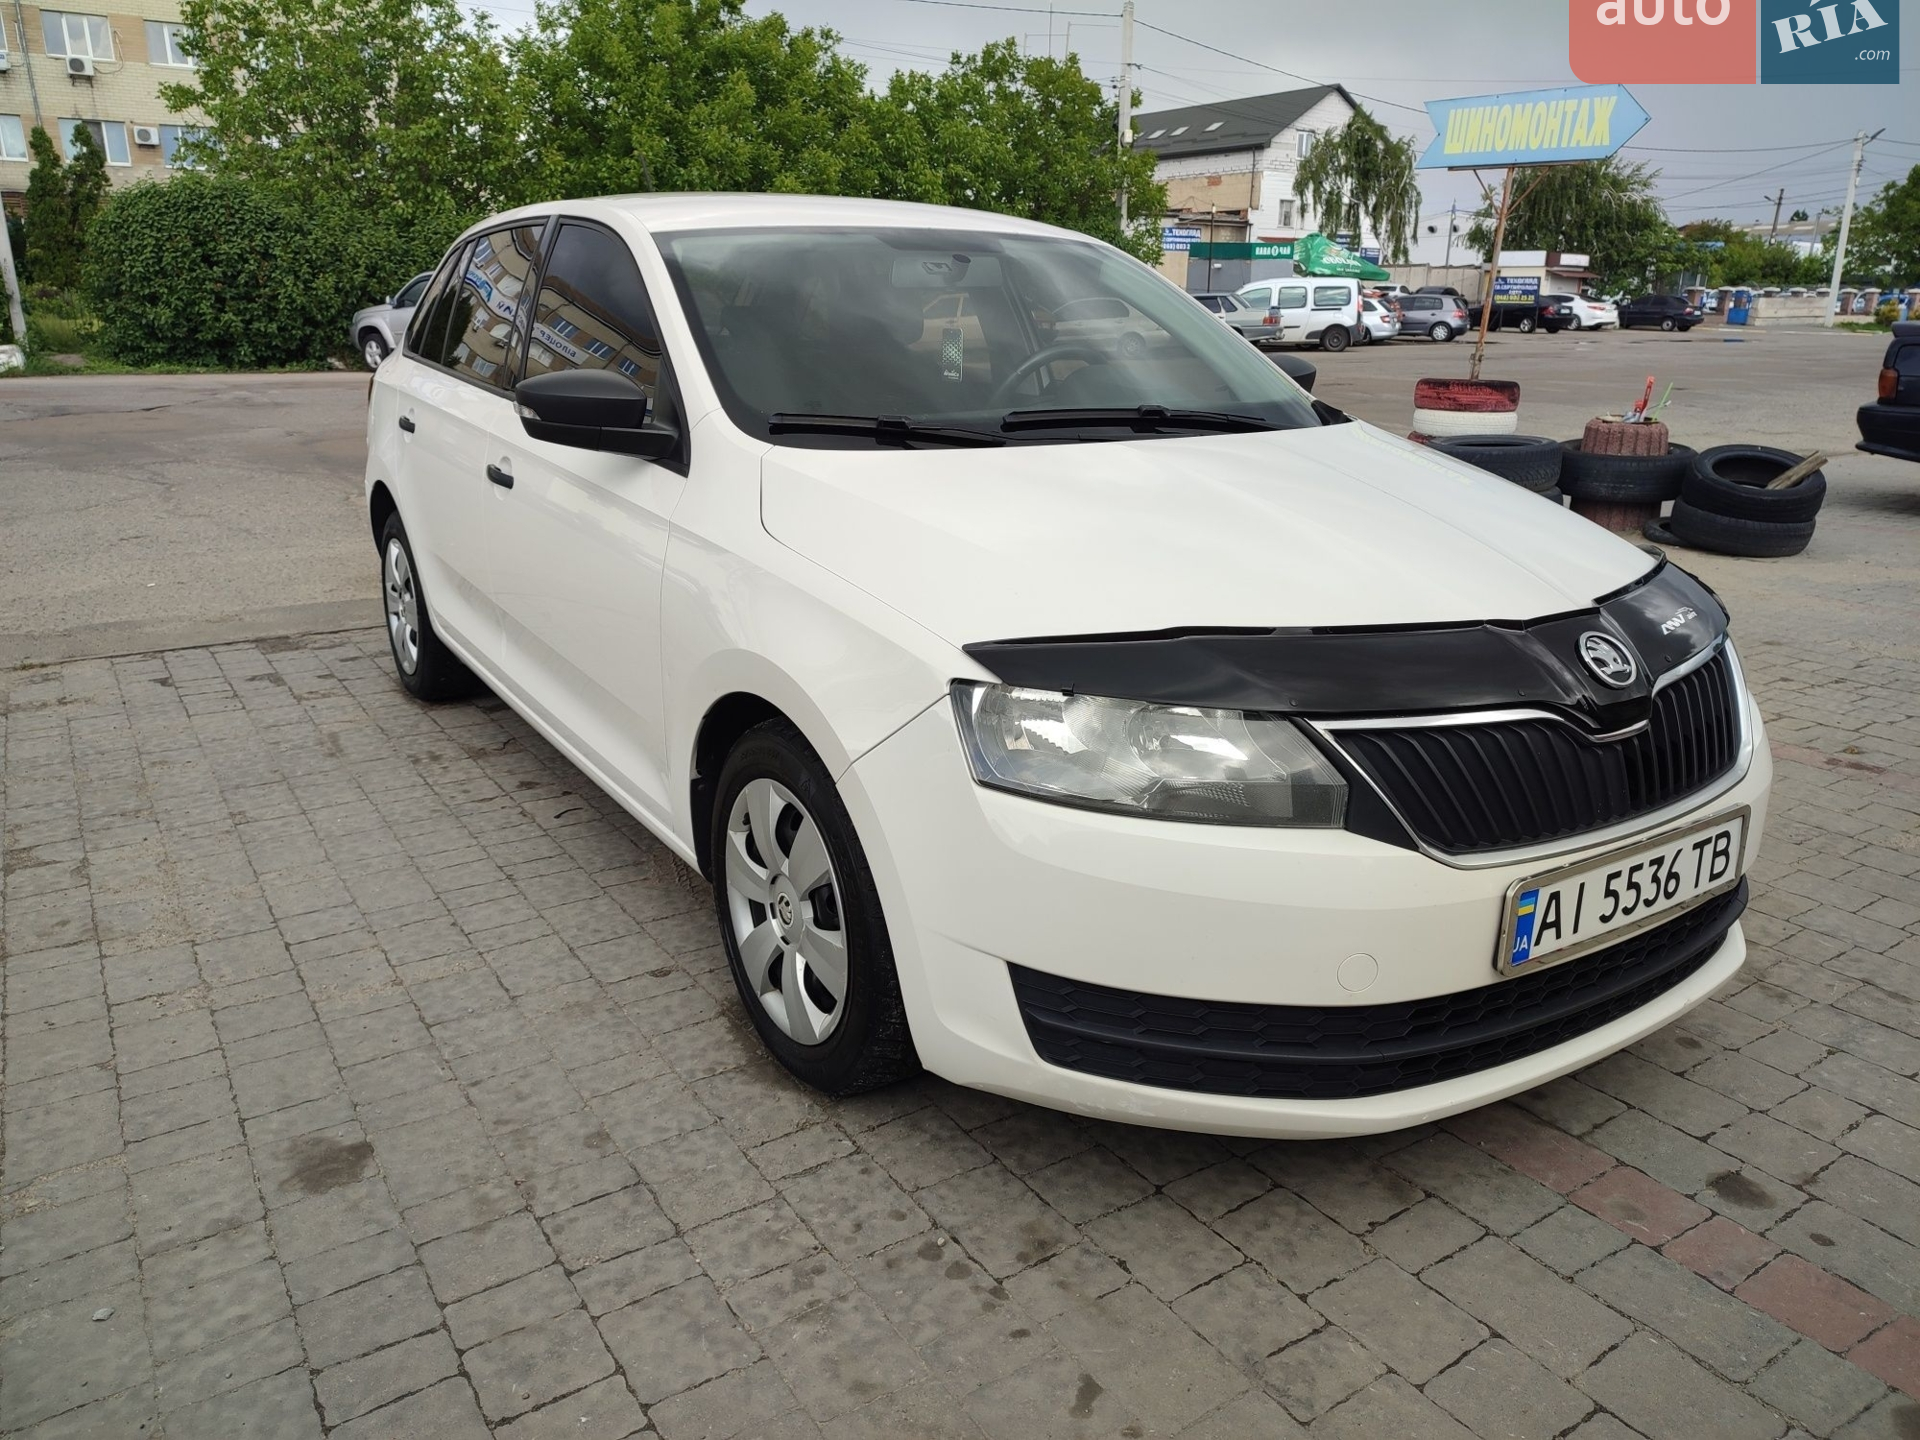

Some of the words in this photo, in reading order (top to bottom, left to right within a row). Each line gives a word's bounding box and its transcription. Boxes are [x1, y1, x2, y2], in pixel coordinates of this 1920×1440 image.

[1443, 96, 1618, 155] ШИНОМОНТАЖ
[1534, 882, 1585, 946] AI
[1599, 848, 1683, 924] 5536
[1692, 829, 1732, 890] TB
